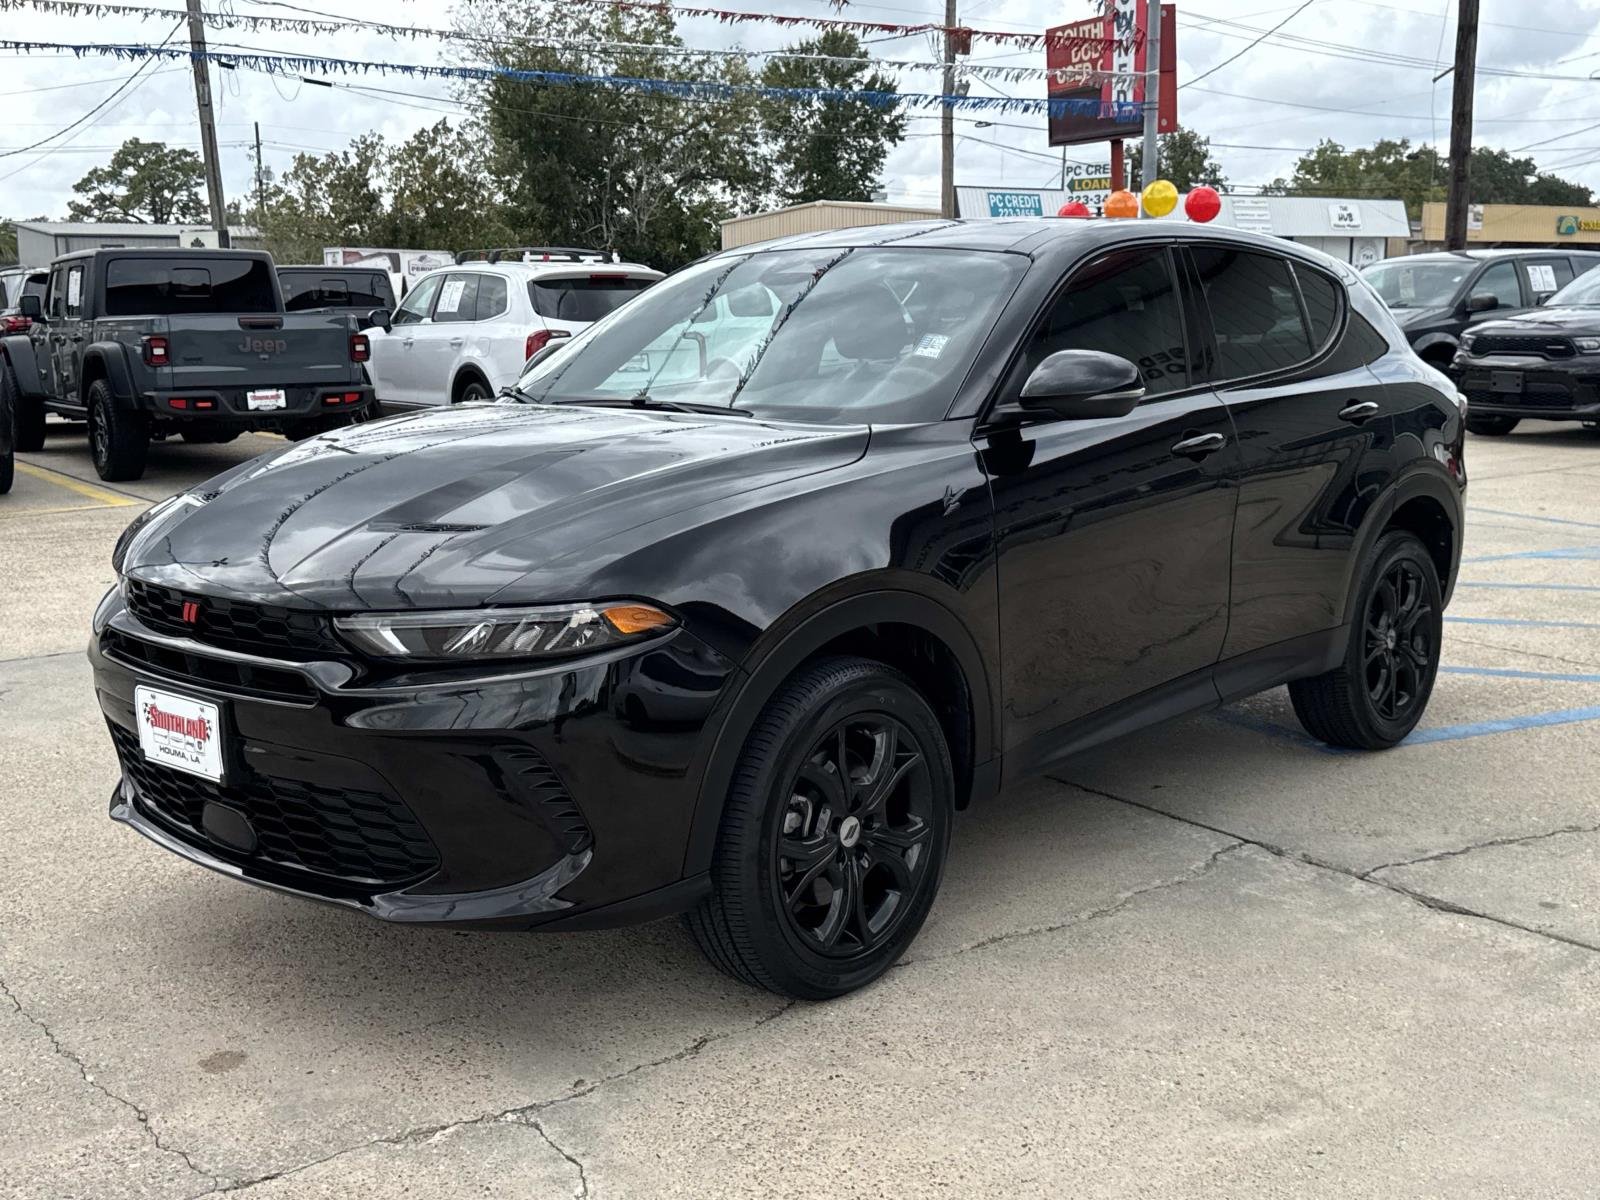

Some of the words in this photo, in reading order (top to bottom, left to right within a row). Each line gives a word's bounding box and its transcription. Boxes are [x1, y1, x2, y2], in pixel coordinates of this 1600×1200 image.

[1066, 166, 1082, 176] PC
[989, 194, 1002, 207] PC
[1004, 195, 1040, 208] CREDIT
[238, 336, 288, 354] Jeep
[149, 704, 207, 742] SOUTHLAND
[159, 745, 189, 762] HOUMA,
[190, 754, 201, 764] LA
